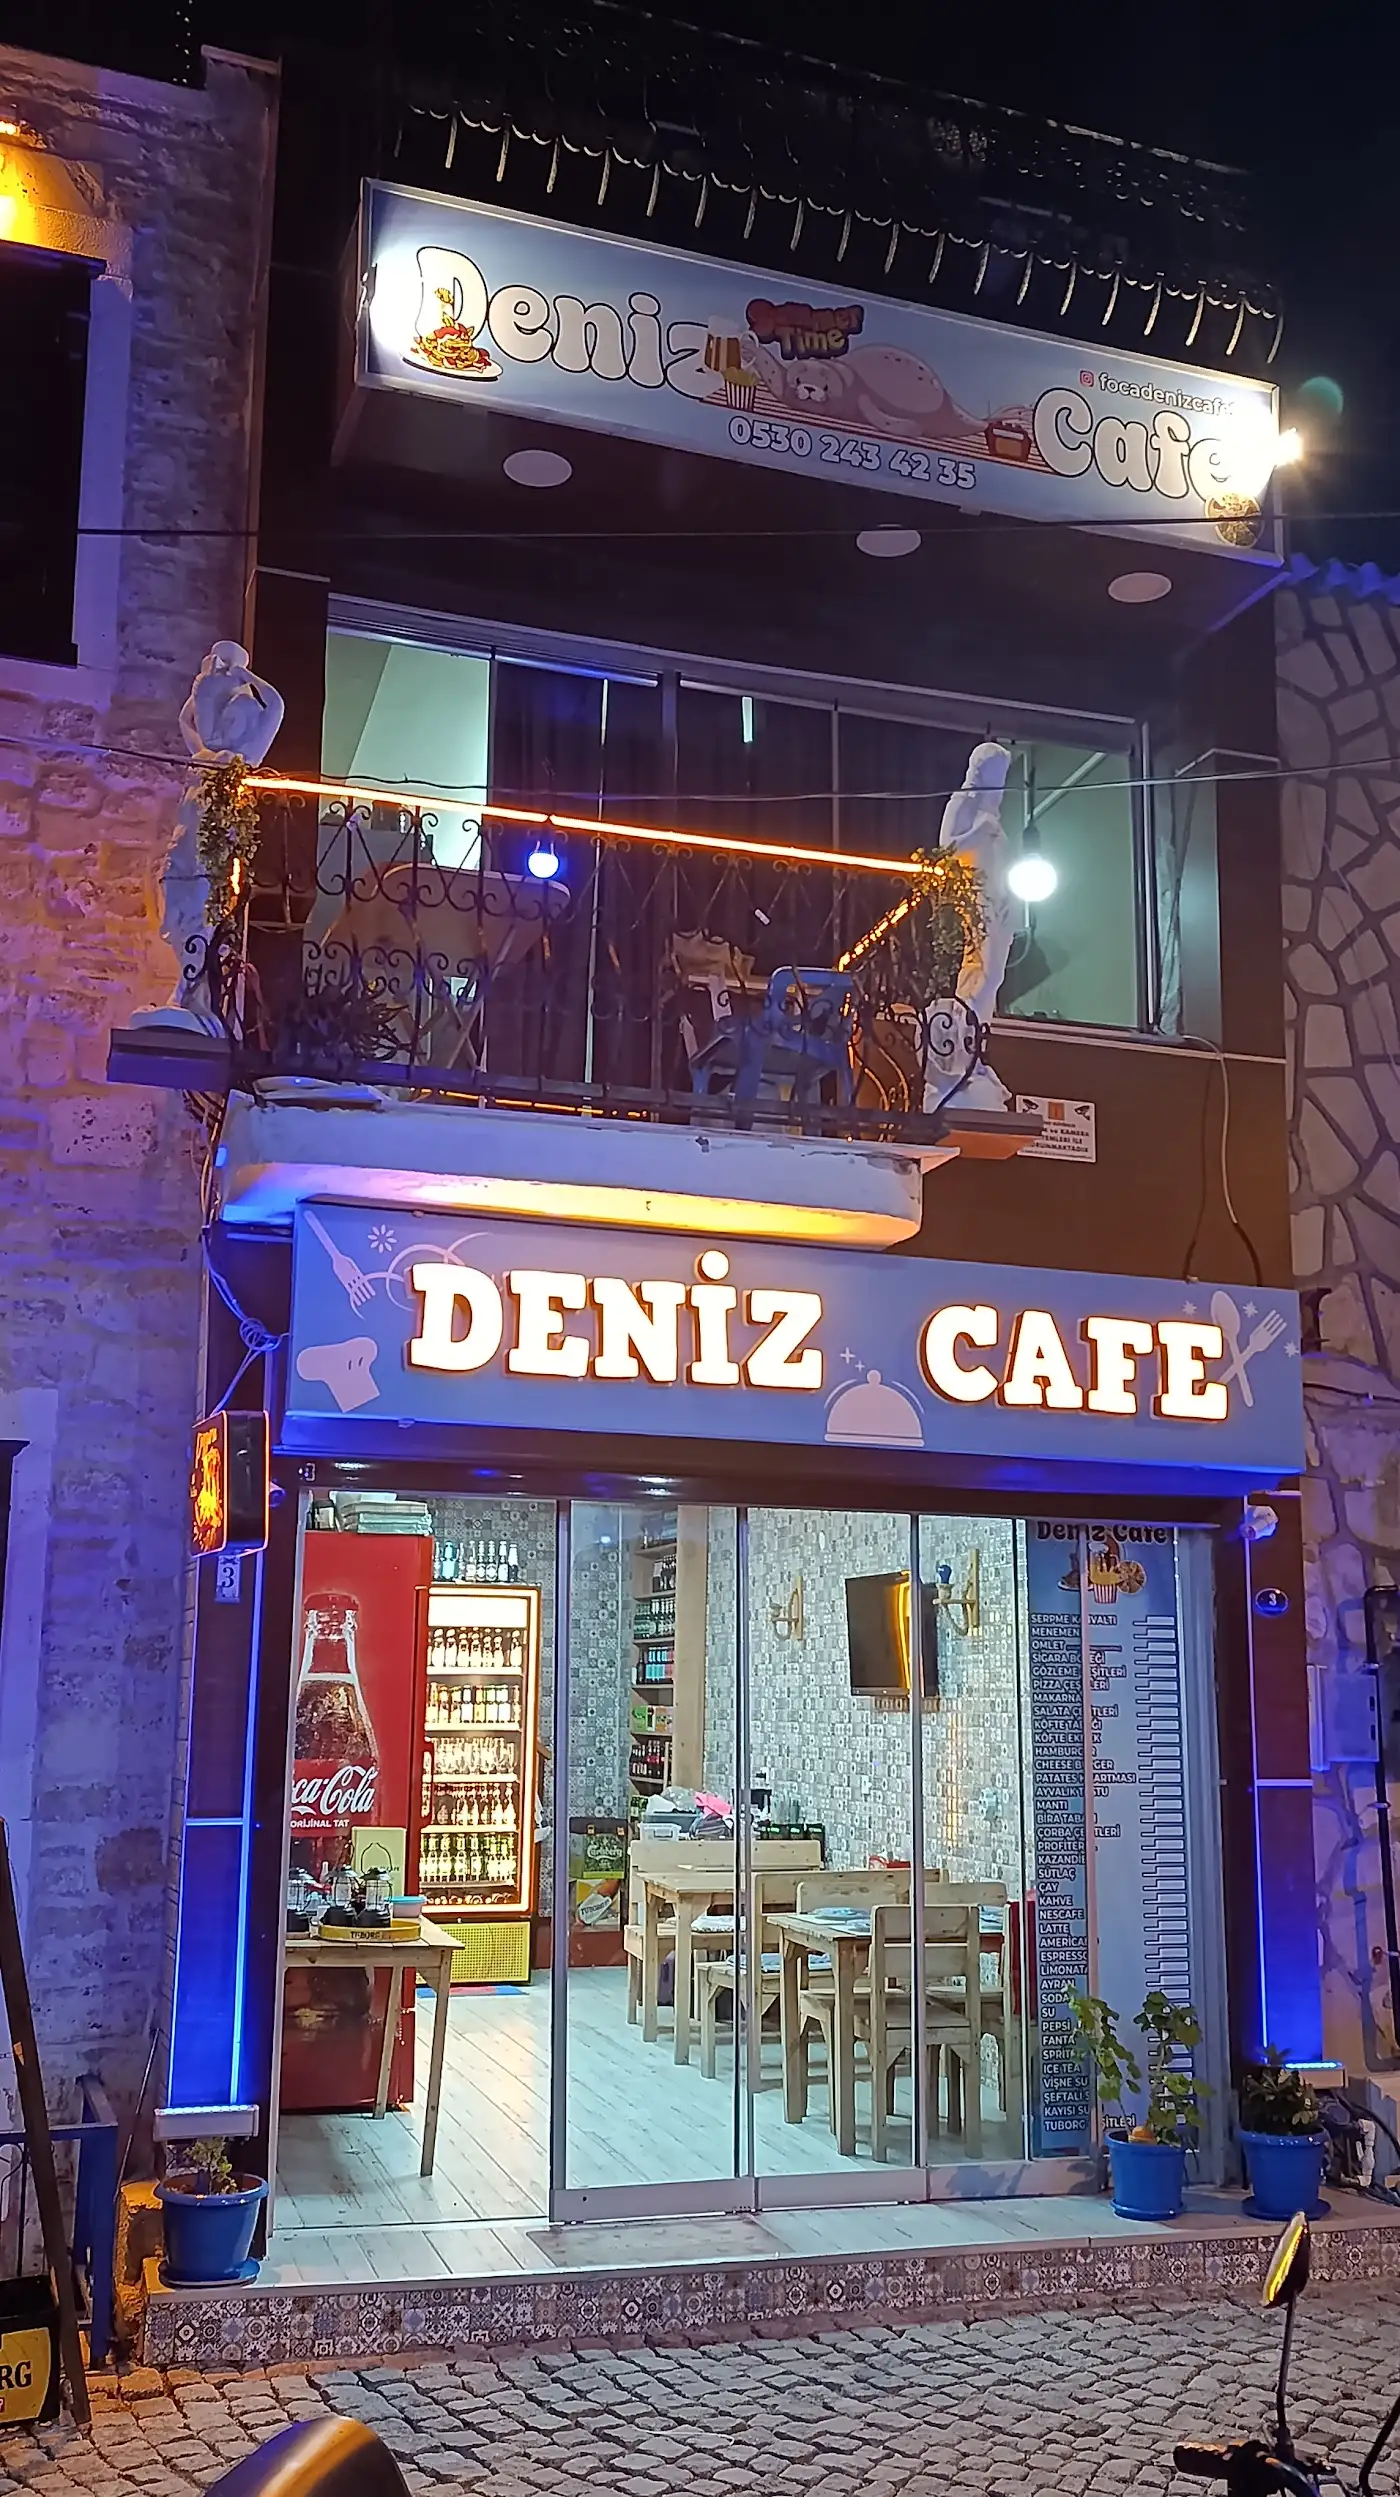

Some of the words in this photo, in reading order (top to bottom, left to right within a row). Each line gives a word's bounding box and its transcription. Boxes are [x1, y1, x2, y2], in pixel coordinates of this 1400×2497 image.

[415, 246, 726, 400] Deniz
[775, 327, 848, 358] Time
[1034, 387, 1247, 503] Cafe
[729, 416, 811, 457] 0530
[820, 435, 881, 471] 243
[889, 450, 930, 481] 42
[938, 459, 976, 490] 35
[407, 1249, 824, 1390] DENİZ
[919, 1304, 1229, 1421] CAFE
[1112, 1524, 1168, 1544] Cafe
[221, 1566, 235, 1588] 3
[1268, 1592, 1277, 1606] 3
[1031, 1614, 1070, 1625] SERPME
[1072, 1614, 1117, 1625] KVALTI
[1031, 1627, 1080, 1638] MENEMEN
[1032, 1640, 1065, 1651] OMLET
[1032, 1652, 1068, 1664] SİGARA
[1032, 1665, 1078, 1677] GÖZLEME
[1033, 1679, 1061, 1690] PİZZA
[1033, 1693, 1082, 1703] MAKARNA
[1034, 1706, 1070, 1717] SALATA
[1034, 1718, 1066, 1730] KÖFTE
[1035, 1731, 1066, 1743] KÖFTE
[1035, 1746, 1097, 1757] HAMBURG
[1035, 1759, 1073, 1770] CHEESE
[1075, 1760, 1114, 1771] BGER
[1036, 1773, 1078, 1784] PATATES
[292, 1765, 379, 1815] ca-Cola
[1036, 1786, 1077, 1797] AYVALIK
[1036, 1800, 1068, 1811] MANTI
[333, 1819, 350, 1828] TAT
[1037, 1811, 1060, 1824] BİRA
[1037, 1827, 1072, 1840] ÇORBA
[1038, 1839, 1090, 1852] PROFİTER
[587, 1844, 623, 1861] Carlsberg
[1038, 1852, 1086, 1865] KAZANDİ
[1038, 1866, 1076, 1881] SÜTLAÇ
[1038, 1882, 1059, 1895] ÇAY
[1039, 1895, 1073, 1907] KAHVE
[1039, 1909, 1084, 1920] NESCAFE
[1040, 1923, 1070, 1934] LATTE
[1040, 1934, 1090, 1948] AMERİCA
[1041, 1979, 1075, 1990] AYRAN
[1041, 1993, 1070, 2004] SODA
[1041, 2007, 1056, 2018] SU
[1042, 2018, 1071, 2032] PEPSİ
[1042, 2035, 1076, 2047] FANTA
[1043, 2063, 1060, 2074] ICE
[1061, 2063, 1081, 2074] TEA
[1043, 2075, 1073, 2090] VİŞNE
[1043, 2088, 1083, 2104] ŞEFTALİ
[1044, 2104, 1076, 2117] KAYISI
[1045, 2120, 1086, 2131] TUBORG
